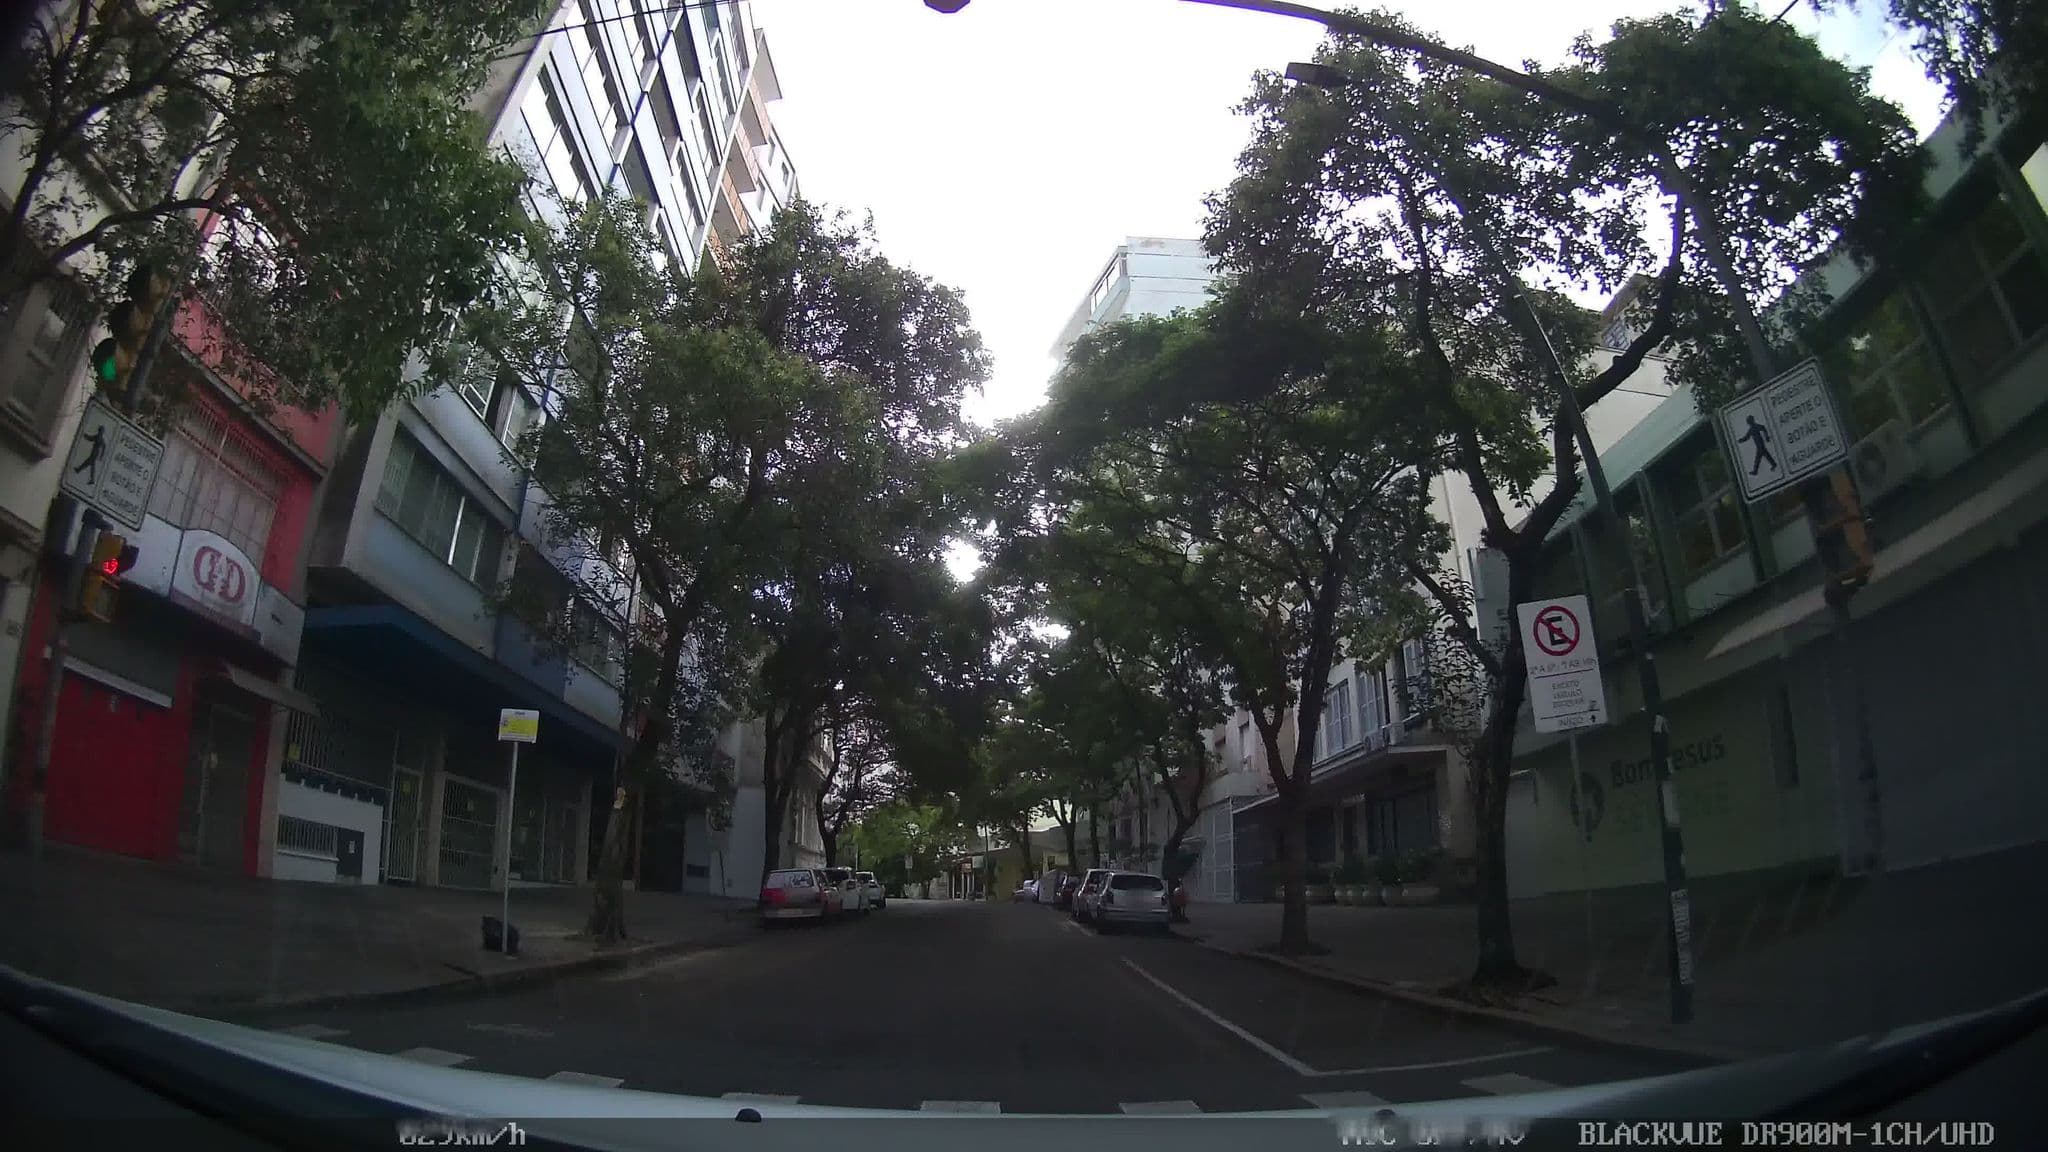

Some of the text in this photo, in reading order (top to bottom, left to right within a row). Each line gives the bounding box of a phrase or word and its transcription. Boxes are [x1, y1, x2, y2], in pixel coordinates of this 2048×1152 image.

[1780, 395, 1821, 424] APERTE O
[1818, 415, 1827, 428] E
[1790, 438, 1836, 465] AGUARDE
